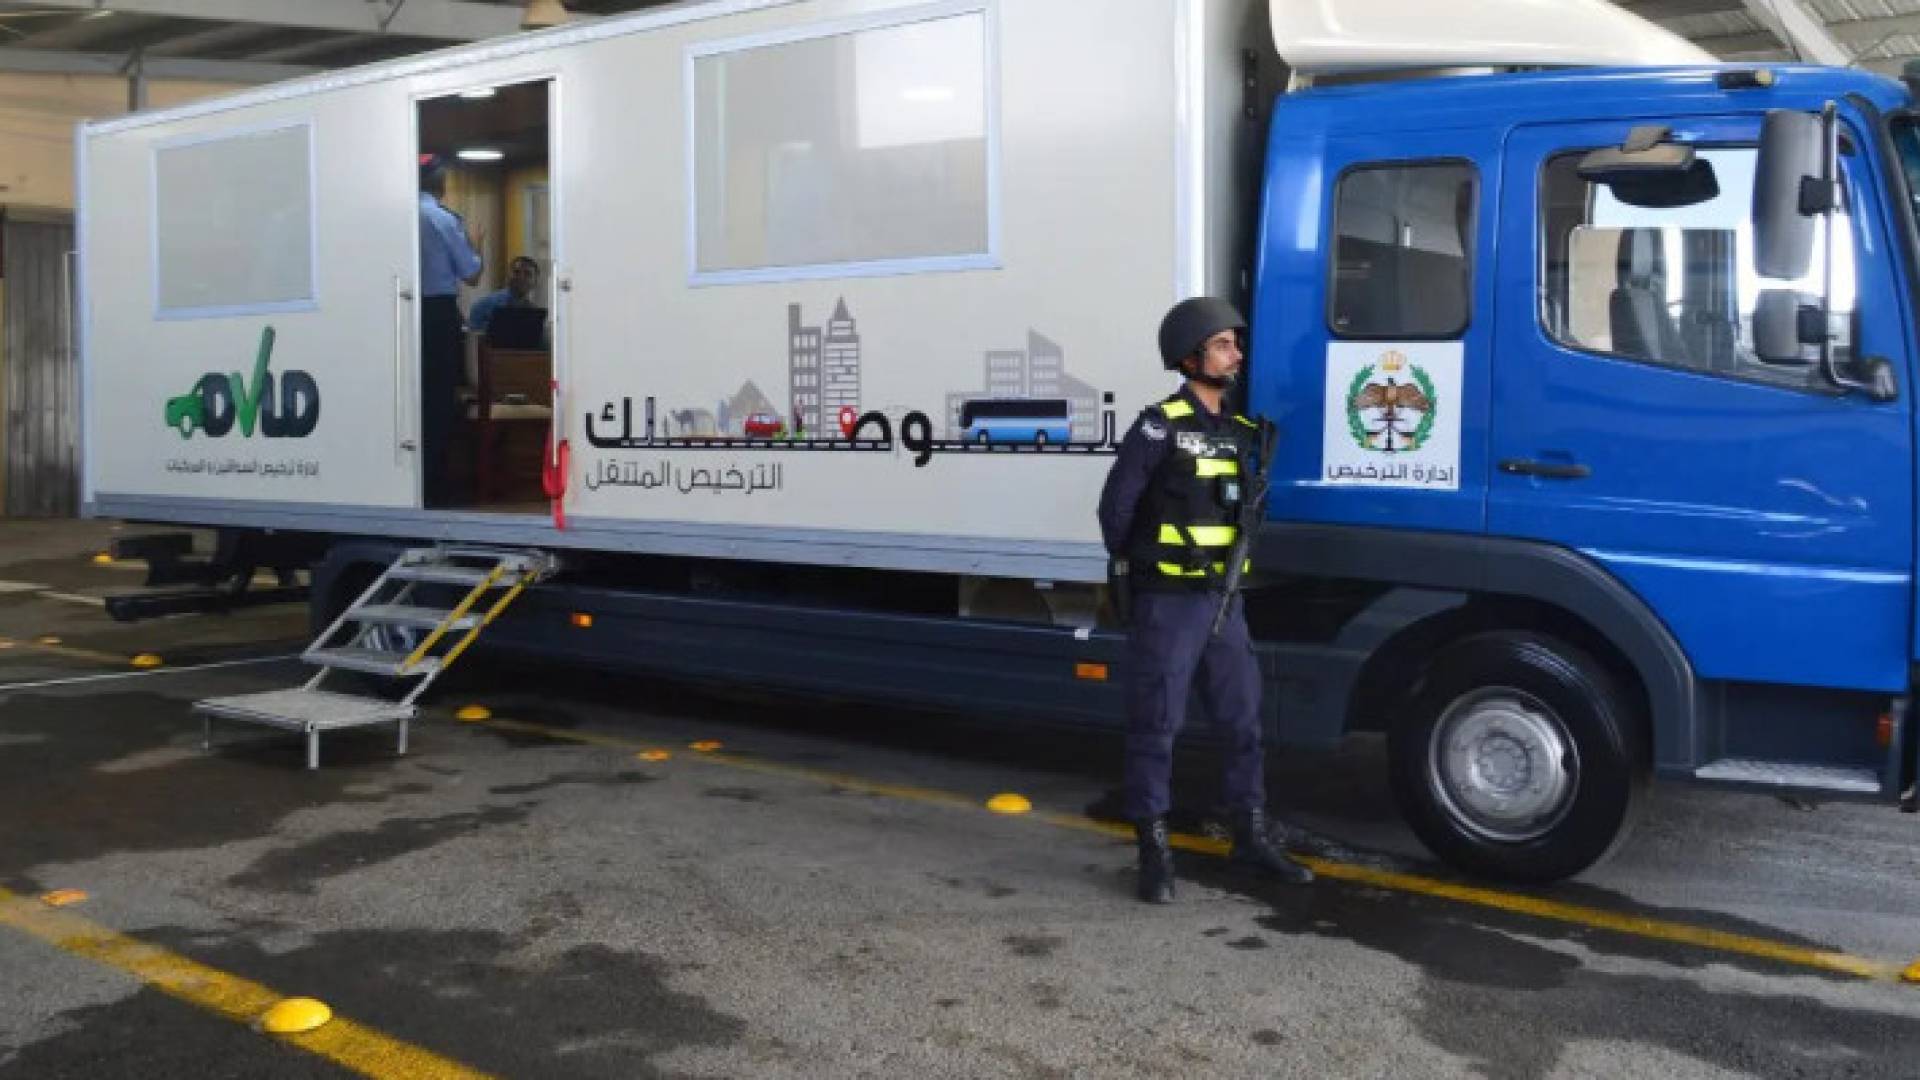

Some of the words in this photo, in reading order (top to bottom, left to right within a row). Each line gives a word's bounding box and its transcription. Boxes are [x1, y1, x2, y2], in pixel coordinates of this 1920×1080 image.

[585, 391, 1121, 468] نوصلك
[585, 458, 670, 491] المتنقل
[675, 462, 783, 495] الترخيص
[1328, 462, 1408, 481] الترخيص
[1413, 463, 1454, 486] إدارة
